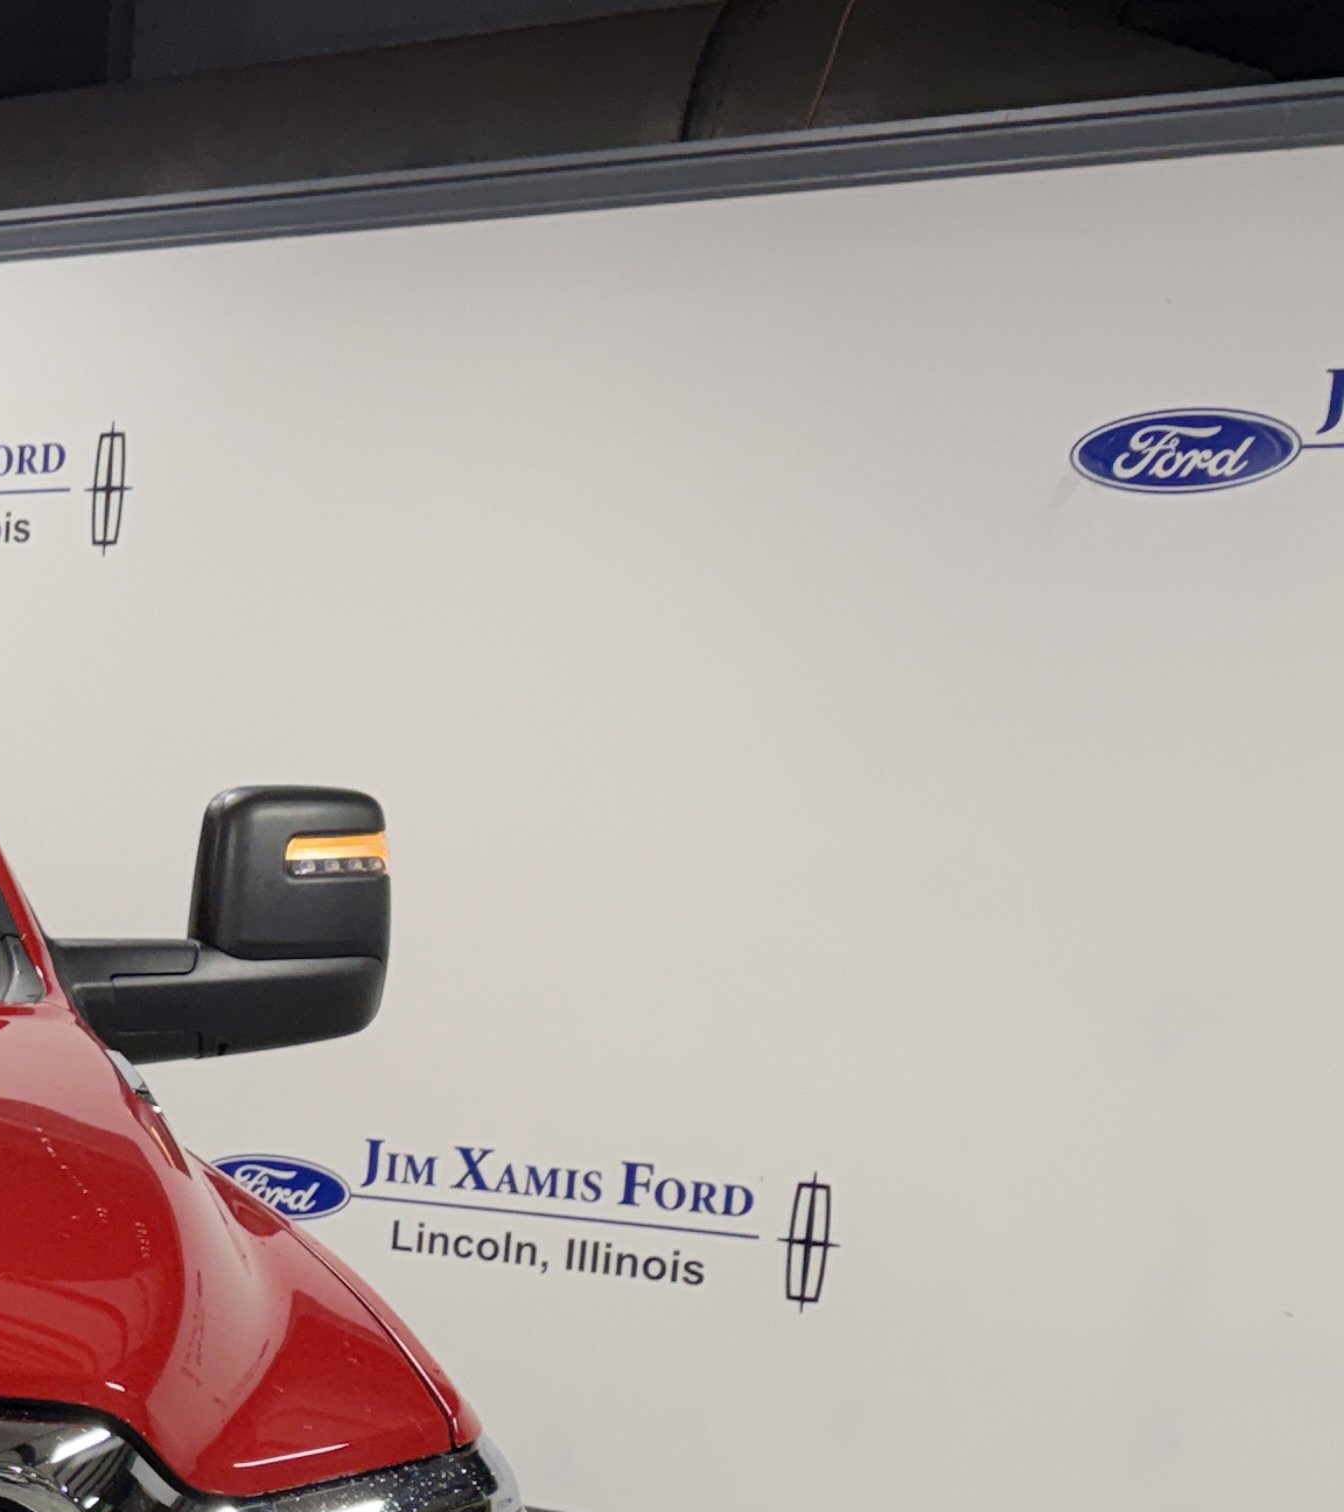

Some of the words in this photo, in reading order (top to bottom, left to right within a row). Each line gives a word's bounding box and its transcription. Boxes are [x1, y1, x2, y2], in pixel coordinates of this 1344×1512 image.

[1113, 424, 1256, 480] Ford
[359, 1138, 438, 1188] JIM
[453, 1145, 604, 1204] XAMIS
[616, 1160, 756, 1219] FORD
[391, 1219, 549, 1274] Lincoln,
[565, 1238, 706, 1287] Illinois
